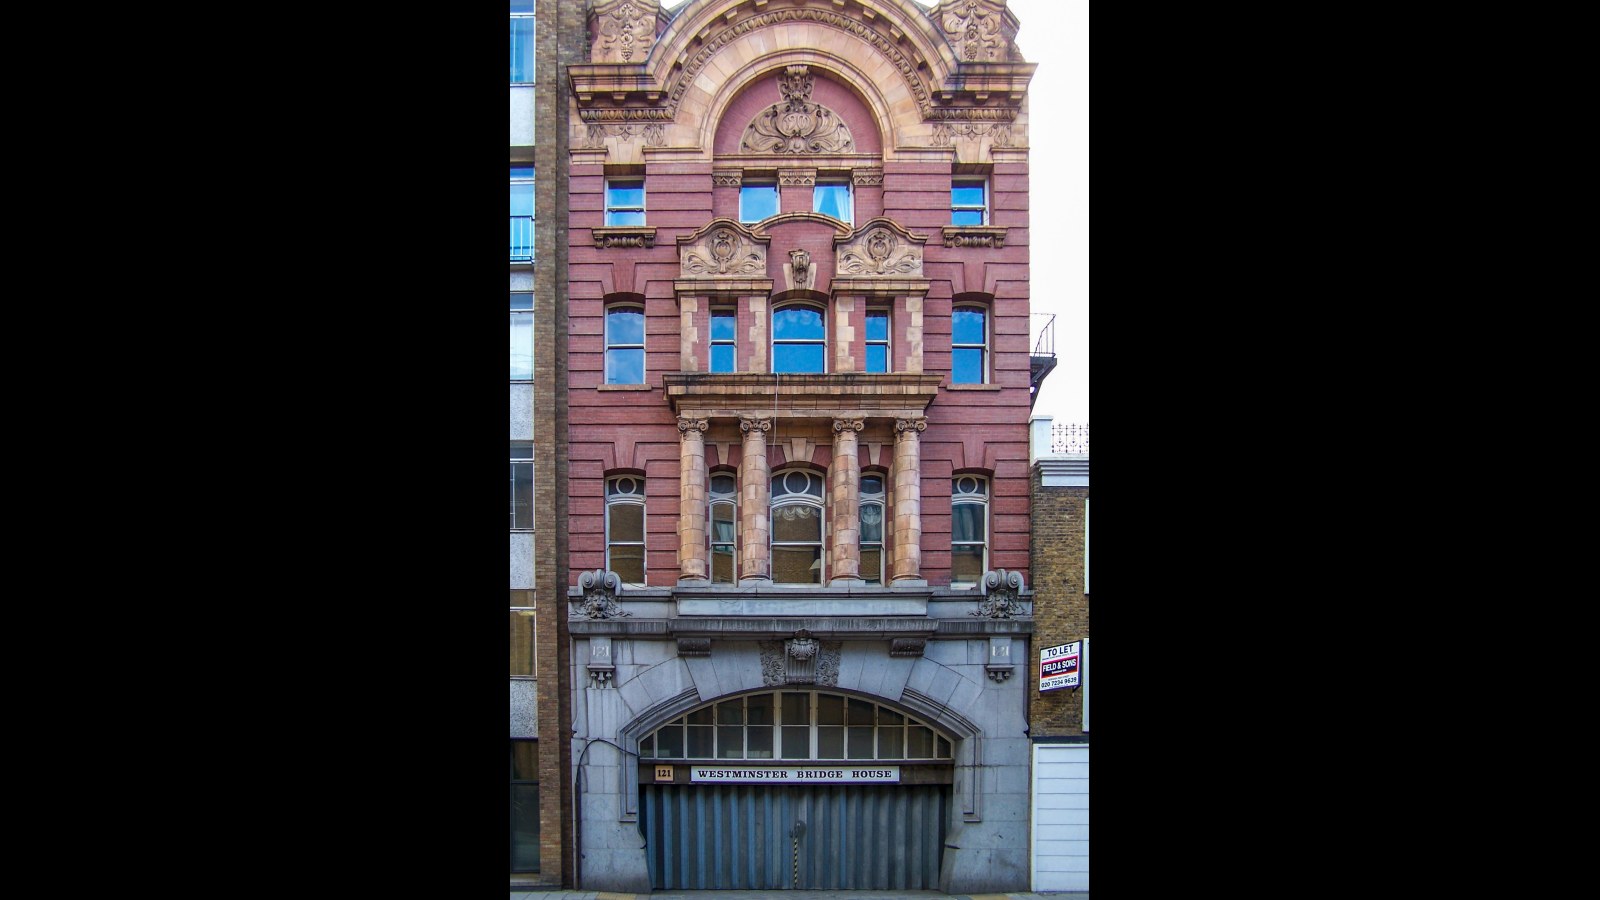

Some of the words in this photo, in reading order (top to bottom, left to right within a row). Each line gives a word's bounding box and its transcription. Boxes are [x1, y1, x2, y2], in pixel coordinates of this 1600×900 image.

[1048, 648, 1057, 656] TO
[1060, 645, 1073, 654] LET
[1043, 662, 1056, 672] FIELD
[1057, 661, 1062, 670] &
[1062, 659, 1076, 668] SONS
[657, 769, 671, 778] 121
[698, 770, 788, 779] WESTMINSTER
[797, 770, 843, 779] BRIDGE
[852, 770, 892, 778] HOUSE
